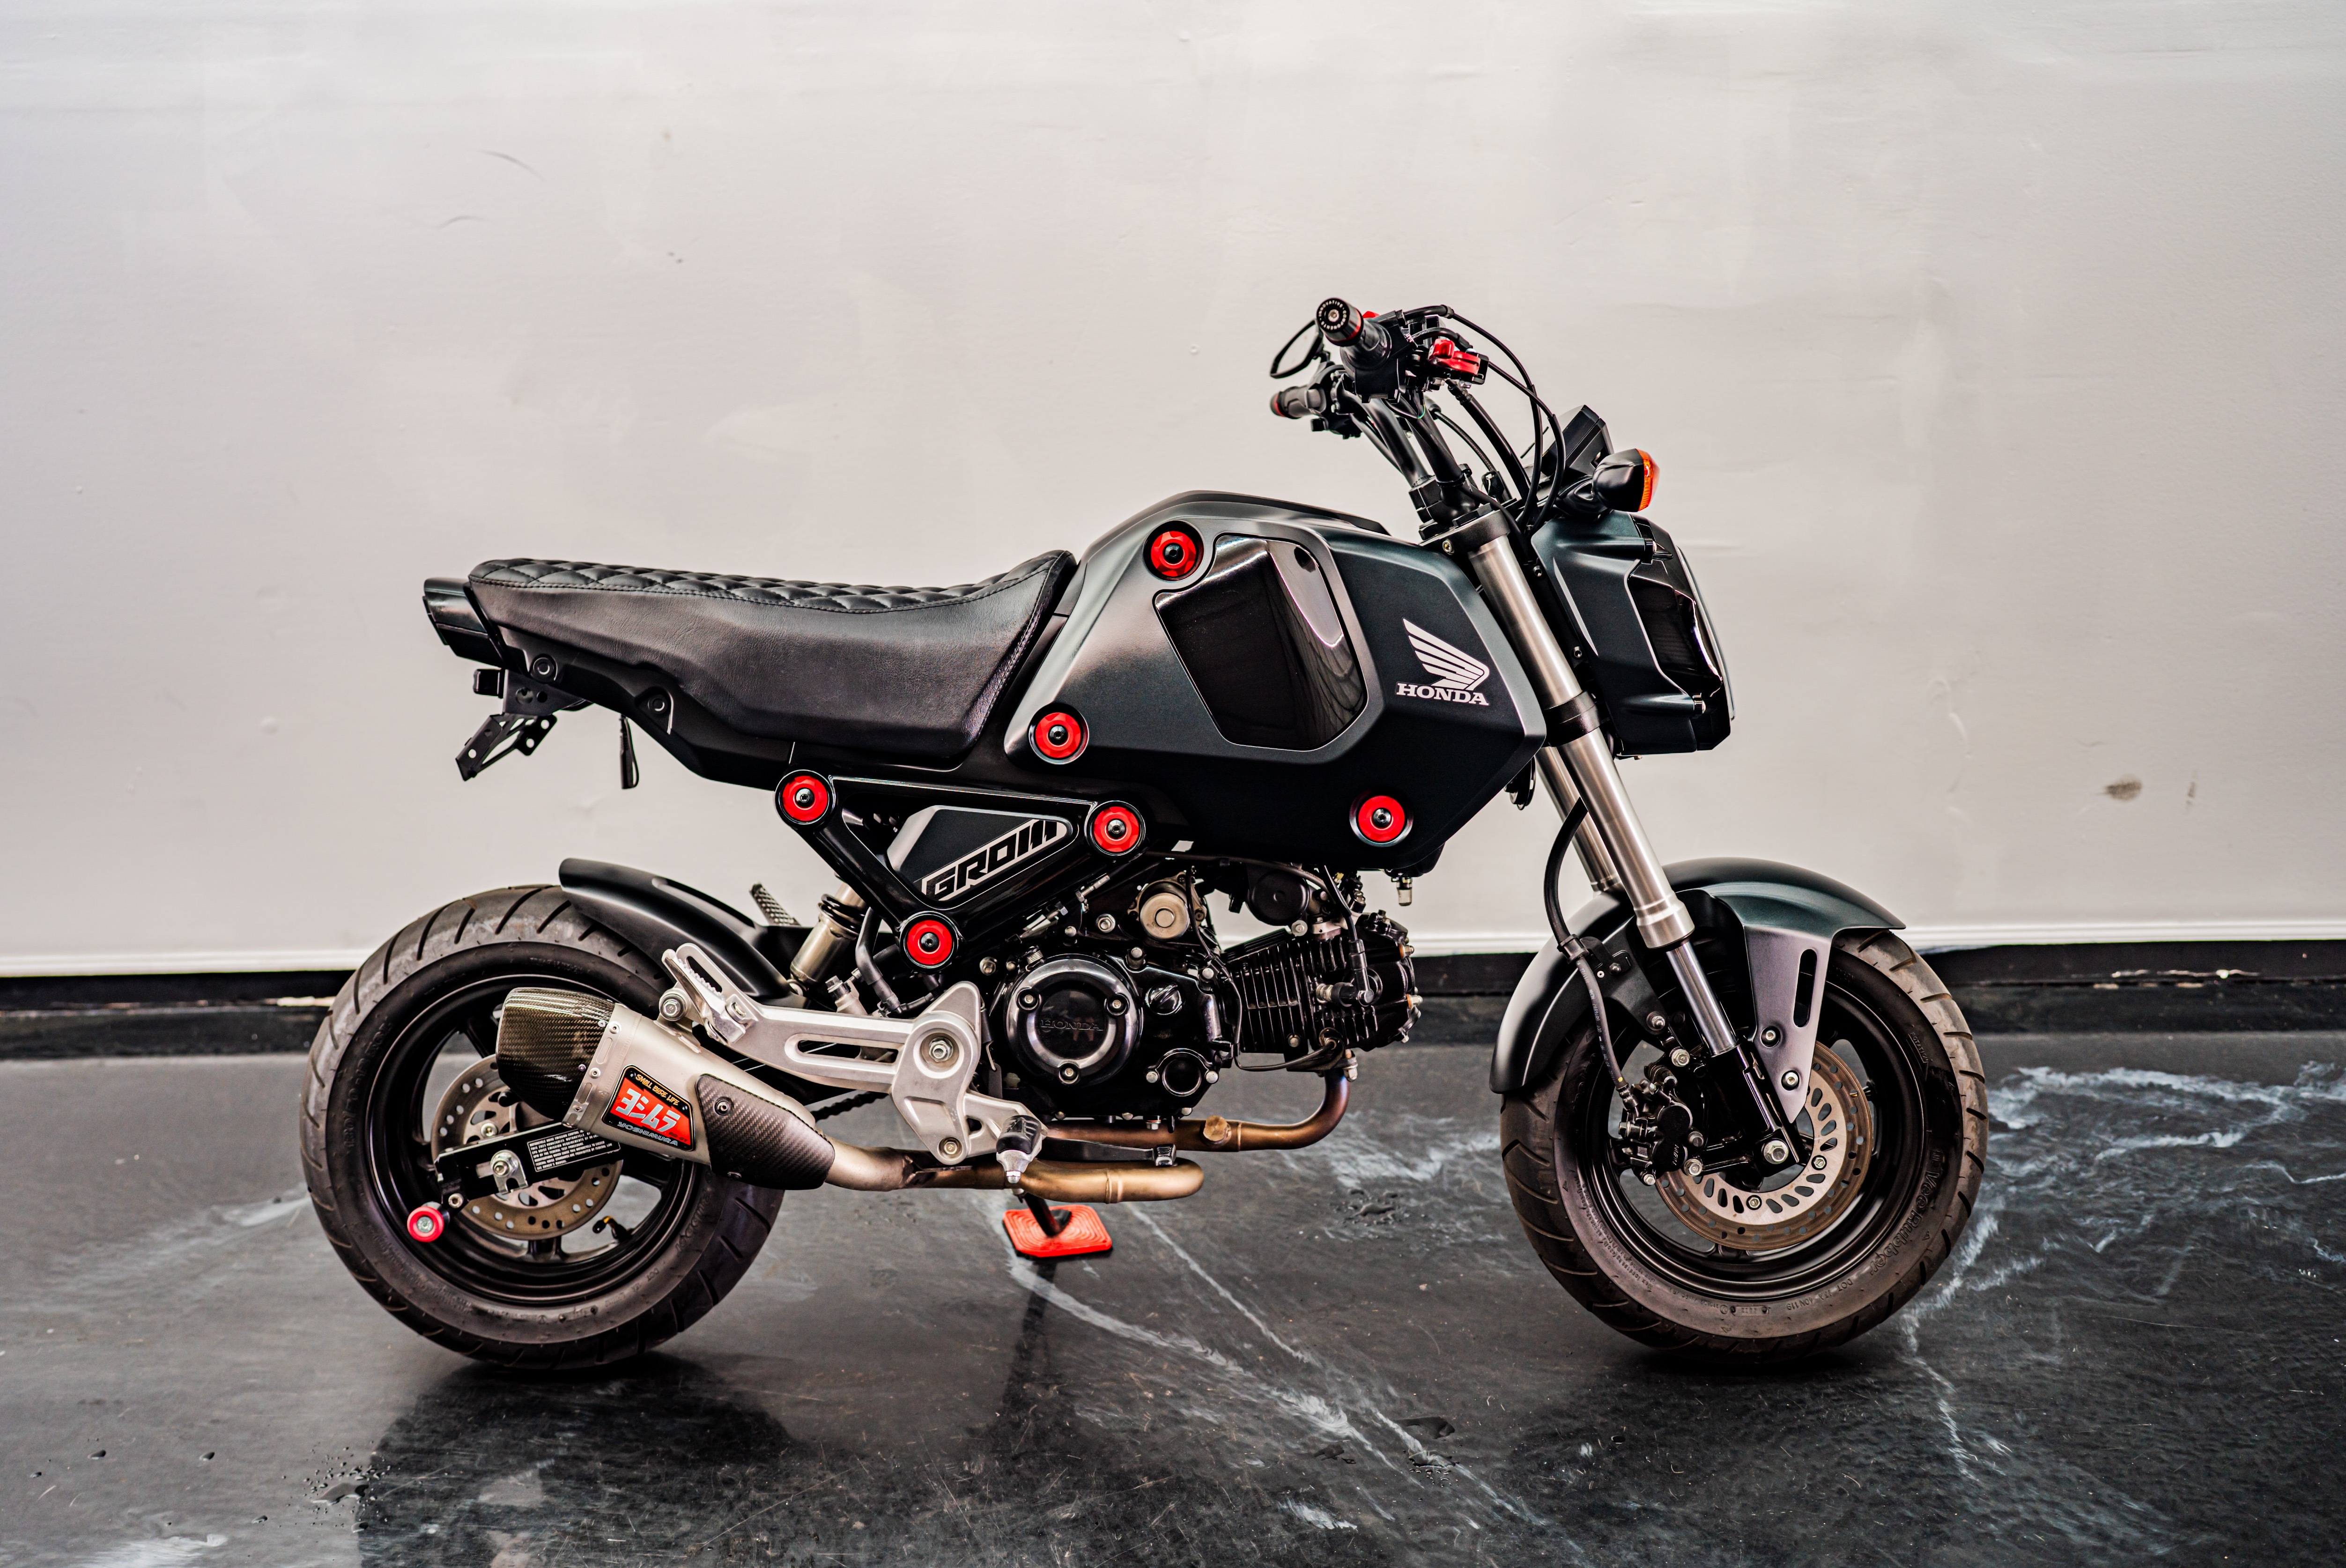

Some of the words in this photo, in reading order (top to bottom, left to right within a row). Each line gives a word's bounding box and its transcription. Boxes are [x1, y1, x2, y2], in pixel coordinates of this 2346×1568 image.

[1318, 300, 1343, 317] INNOVATIVE
[1321, 310, 1347, 330] COMPONENTS
[1396, 682, 1490, 706] HONDA
[925, 820, 1058, 900] GROM
[1040, 1018, 1103, 1032] HONDA
[1909, 1031, 1929, 1064] ROTATION
[636, 1073, 653, 1088] SMALL
[652, 1085, 668, 1098] BORE
[666, 1094, 681, 1106] LIFE
[615, 1088, 681, 1132] ヨシムラ
[617, 1121, 678, 1146] YOSHIMURA
[1913, 1169, 1940, 1212] Vee
[1864, 1208, 1924, 1278] Rubber
[1835, 1278, 1854, 1293] DOT
